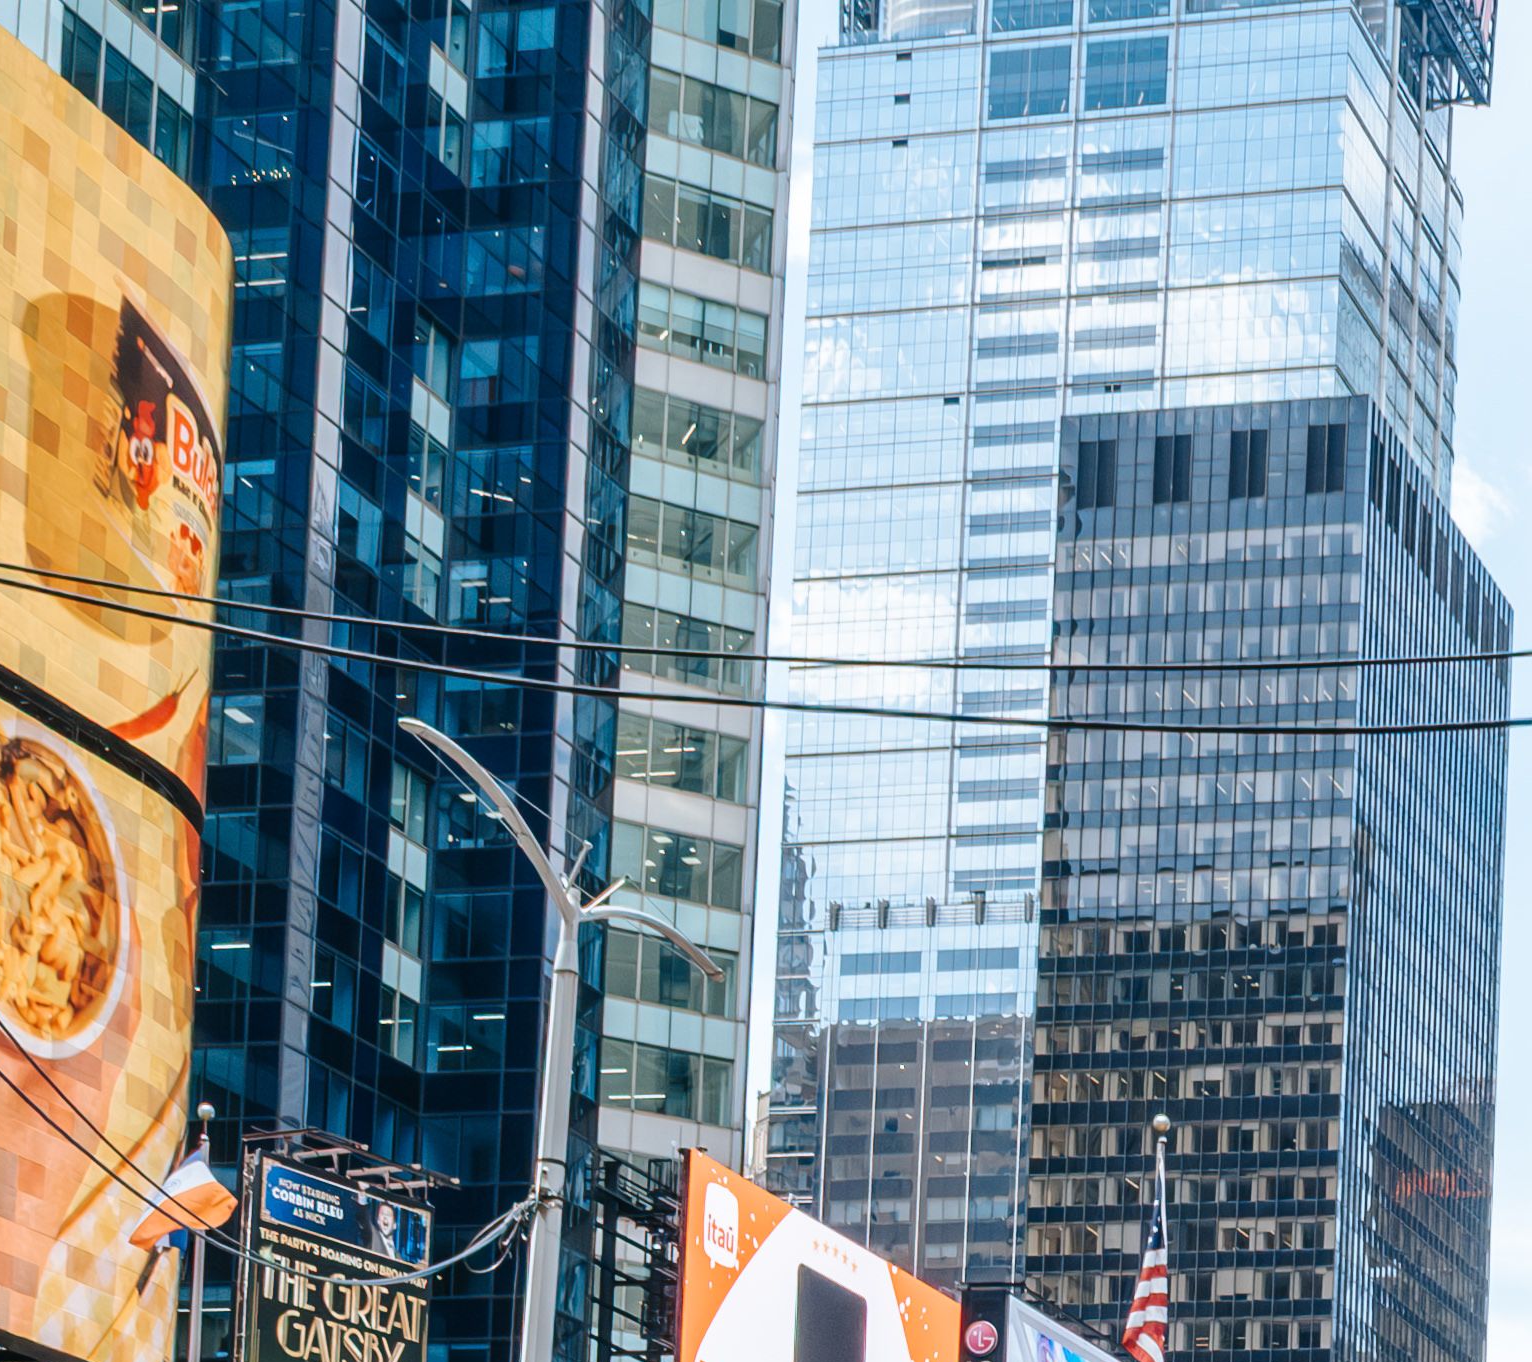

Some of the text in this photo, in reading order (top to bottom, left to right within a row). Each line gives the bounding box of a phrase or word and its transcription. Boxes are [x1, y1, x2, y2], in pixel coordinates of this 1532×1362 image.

[259, 1227, 280, 1244] THE
[261, 1253, 428, 1344] THE GREAT
